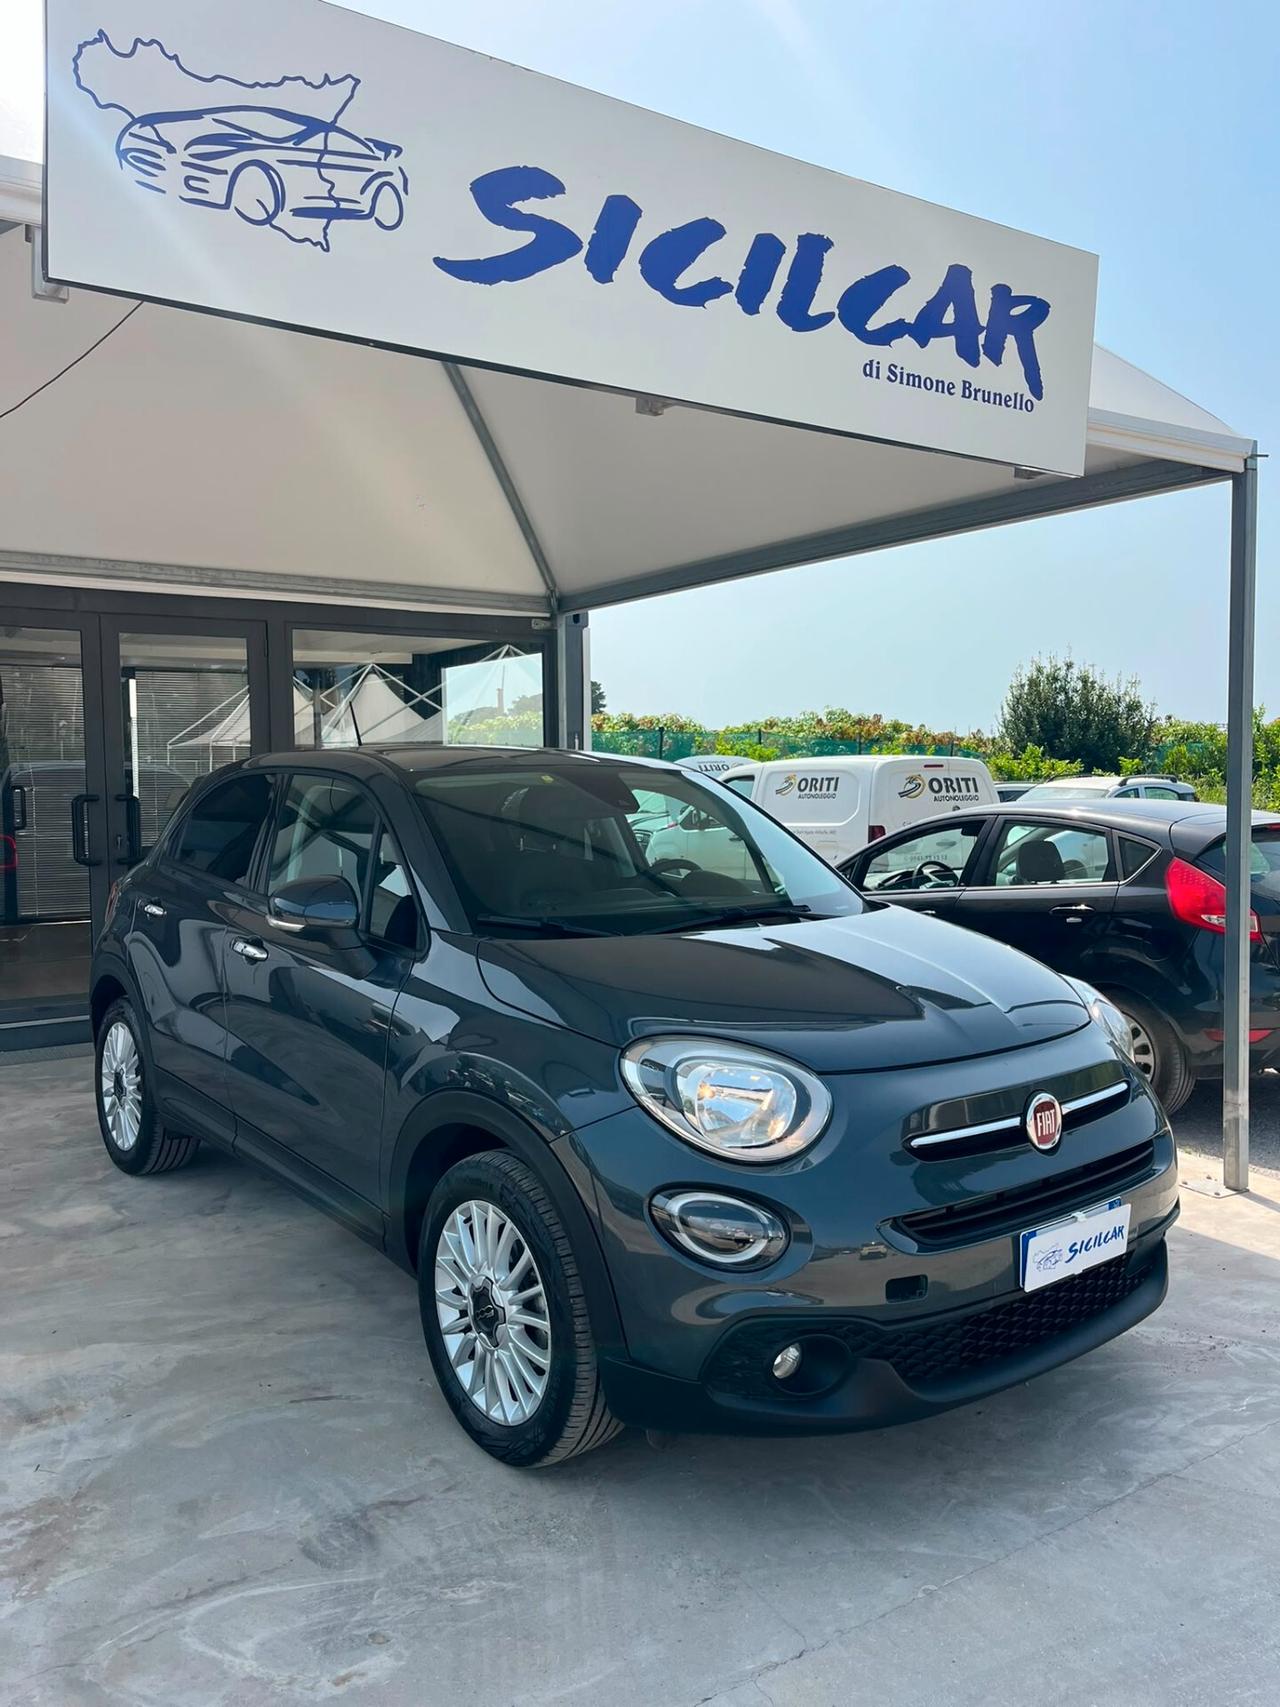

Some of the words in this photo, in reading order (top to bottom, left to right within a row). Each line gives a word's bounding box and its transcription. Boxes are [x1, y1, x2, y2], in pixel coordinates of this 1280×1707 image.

[433, 165, 1051, 401] SICILCAR
[862, 359, 881, 380] di
[886, 363, 956, 396] Simone
[961, 379, 1035, 413] Brunello
[797, 776, 840, 792] ORITI
[928, 777, 979, 794] ORITI
[798, 792, 837, 800] AUTONOLEGGIO
[933, 794, 980, 802] AUTONOLEGGIO
[1036, 1108, 1055, 1137] FIAT
[1064, 1225, 1125, 1264] SICILCAR
